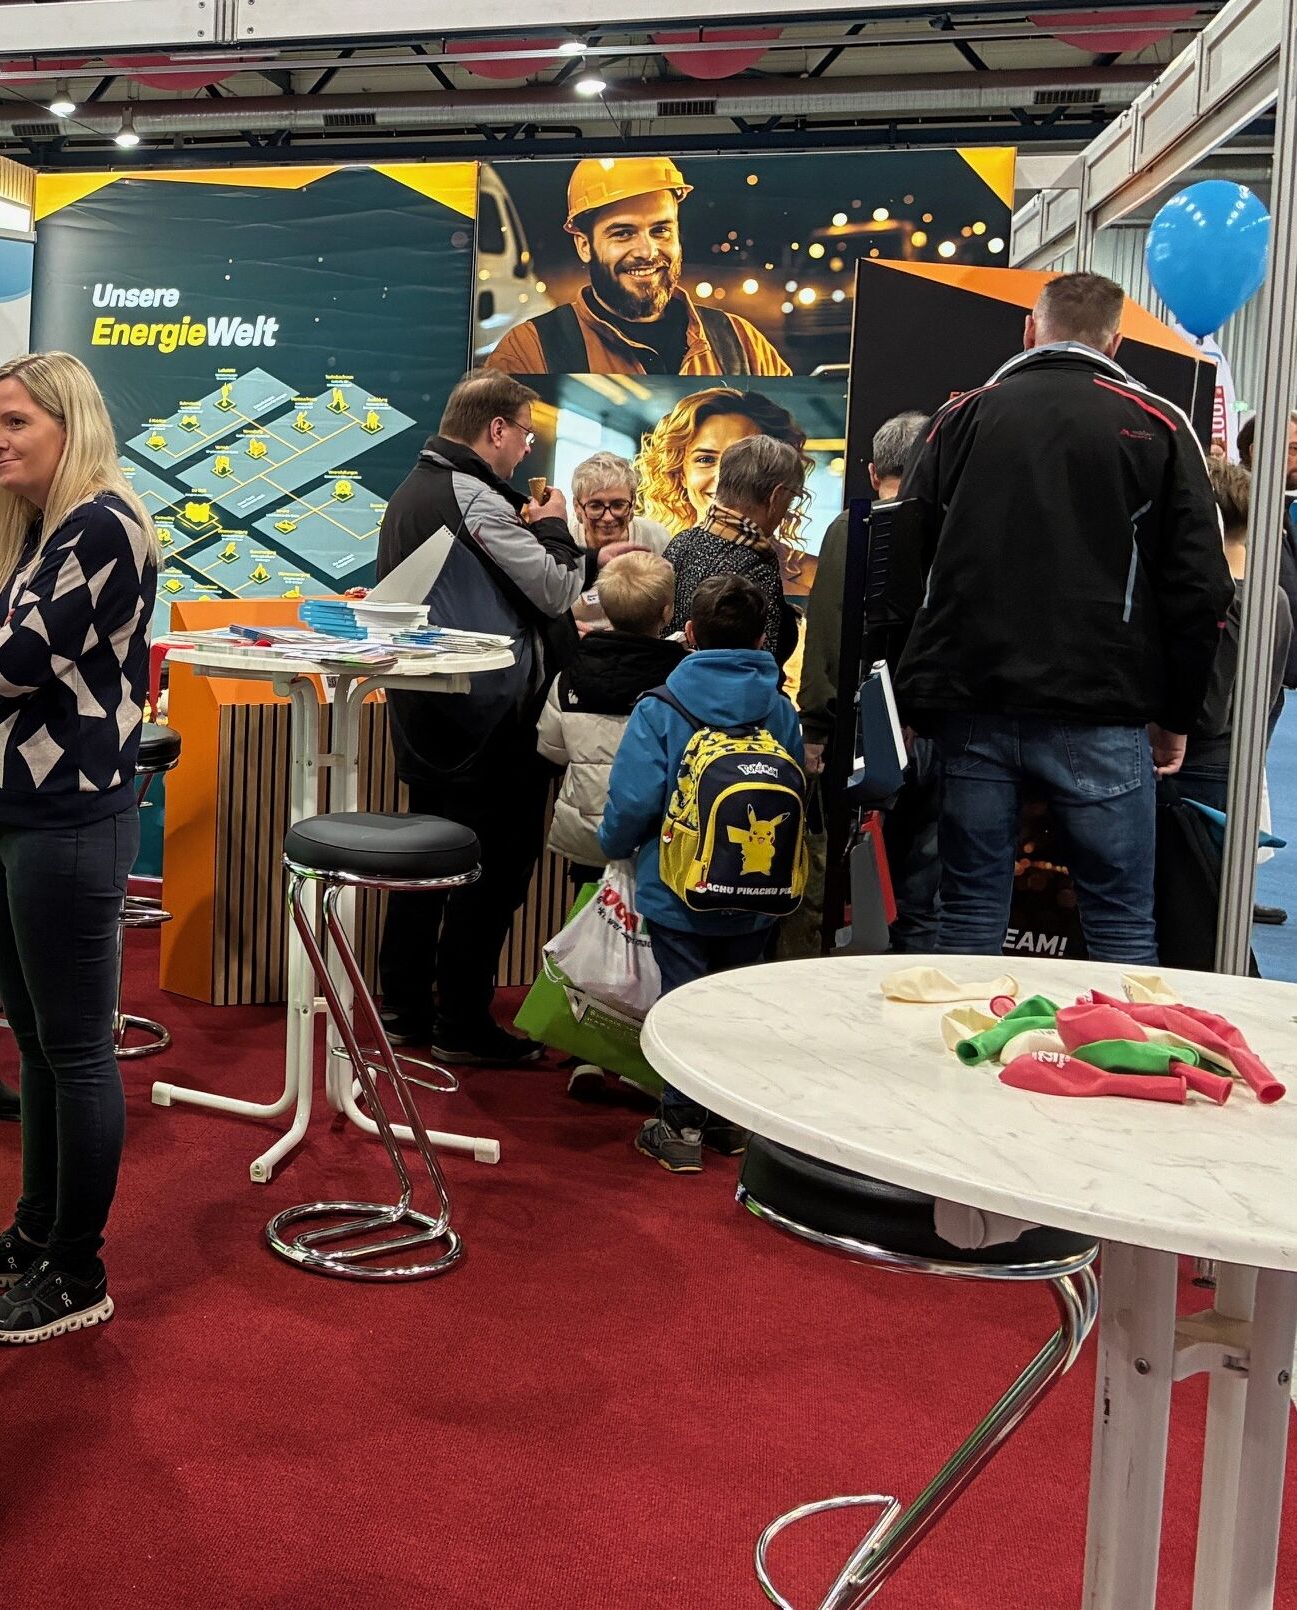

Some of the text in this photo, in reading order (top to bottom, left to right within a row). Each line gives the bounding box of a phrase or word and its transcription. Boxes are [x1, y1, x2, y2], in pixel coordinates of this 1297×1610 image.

[92, 283, 181, 308] Unsere
[91, 315, 280, 354] EnergieWelt
[736, 886, 778, 896] PIKACHU
